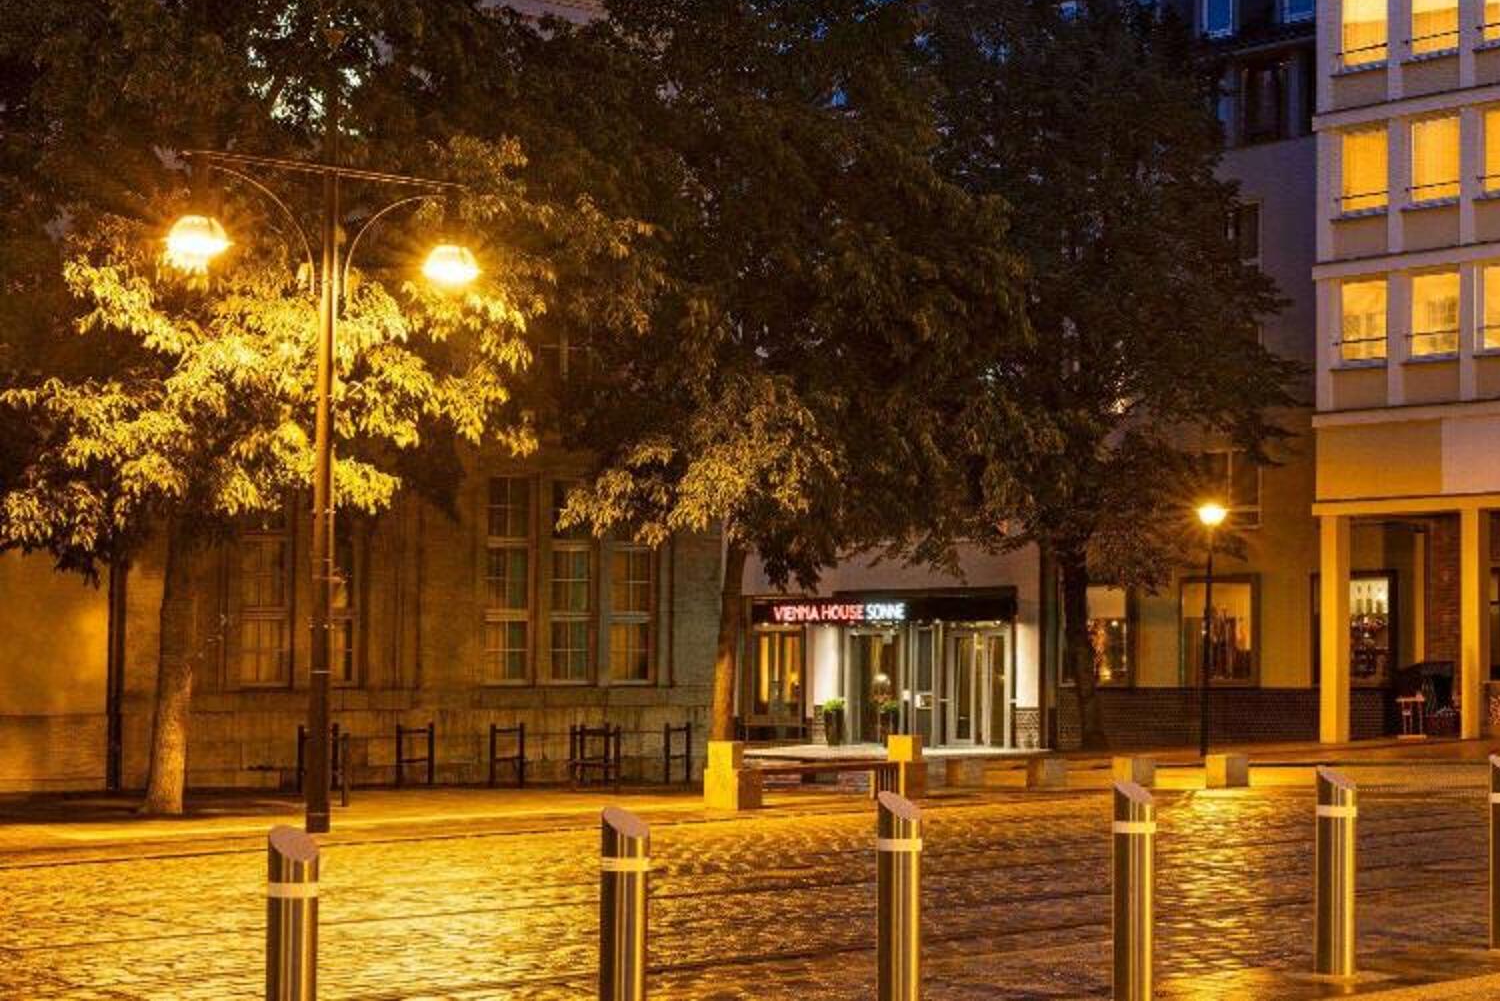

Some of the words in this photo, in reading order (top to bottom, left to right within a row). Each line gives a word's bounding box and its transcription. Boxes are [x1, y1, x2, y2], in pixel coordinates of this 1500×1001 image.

[773, 605, 820, 621] VIENNA
[821, 604, 865, 620] HOUSE
[865, 602, 905, 620] SONNE
